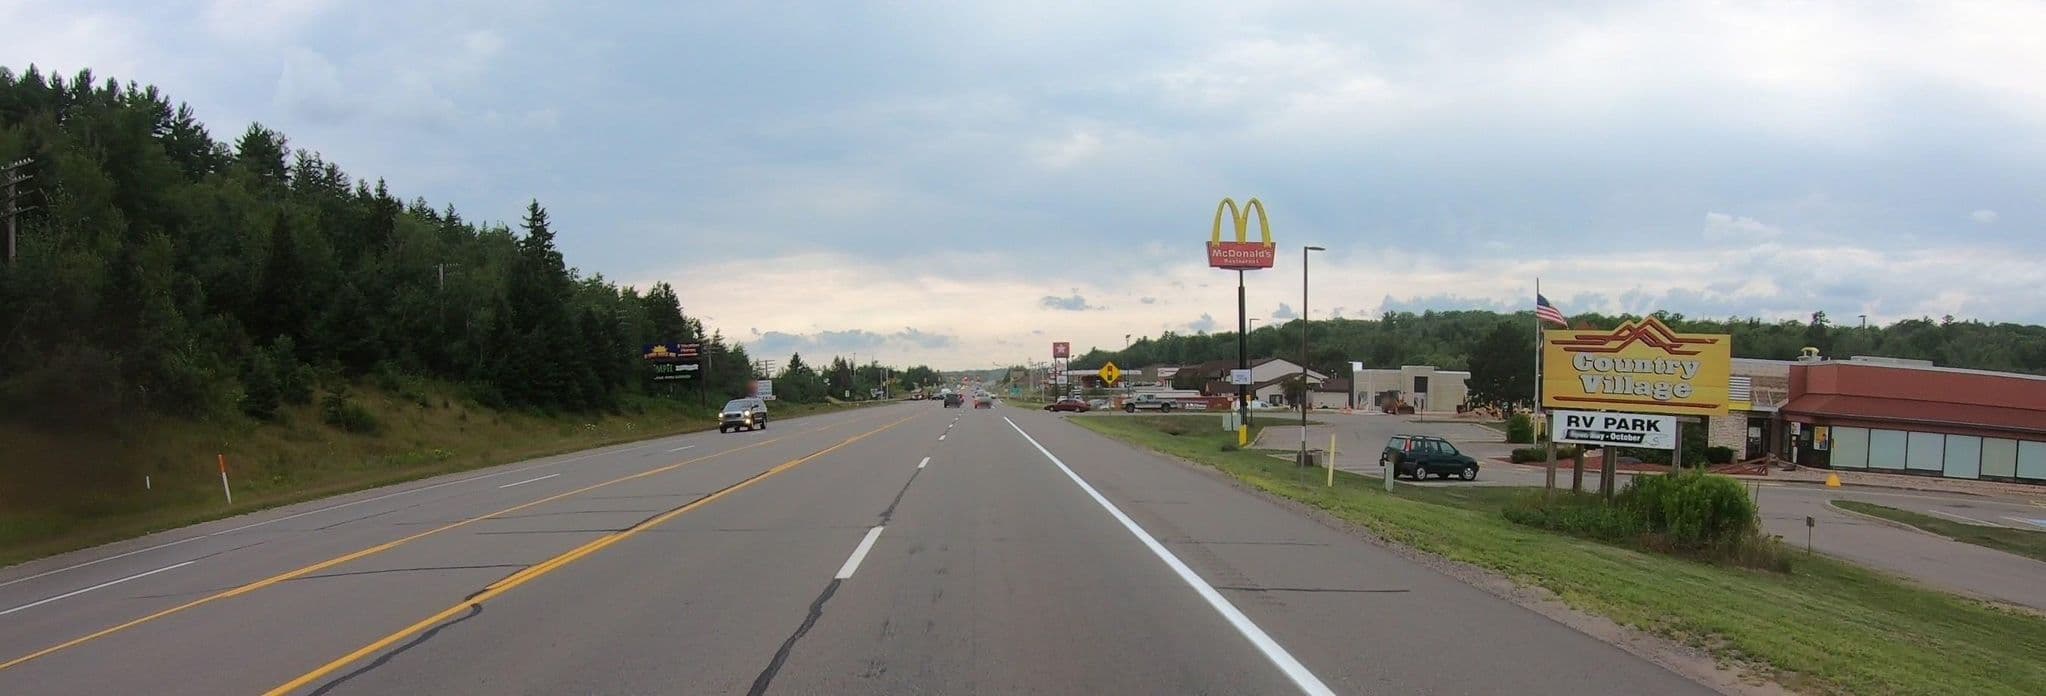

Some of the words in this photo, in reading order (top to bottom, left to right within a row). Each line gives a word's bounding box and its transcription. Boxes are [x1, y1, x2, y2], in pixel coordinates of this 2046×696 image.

[1212, 249, 1272, 258] McDonald's
[1572, 352, 1700, 380] Country
[1579, 375, 1693, 400] Village
[1567, 415, 1595, 428] RV
[1604, 417, 1660, 432] PARK
[1610, 432, 1642, 442] October
